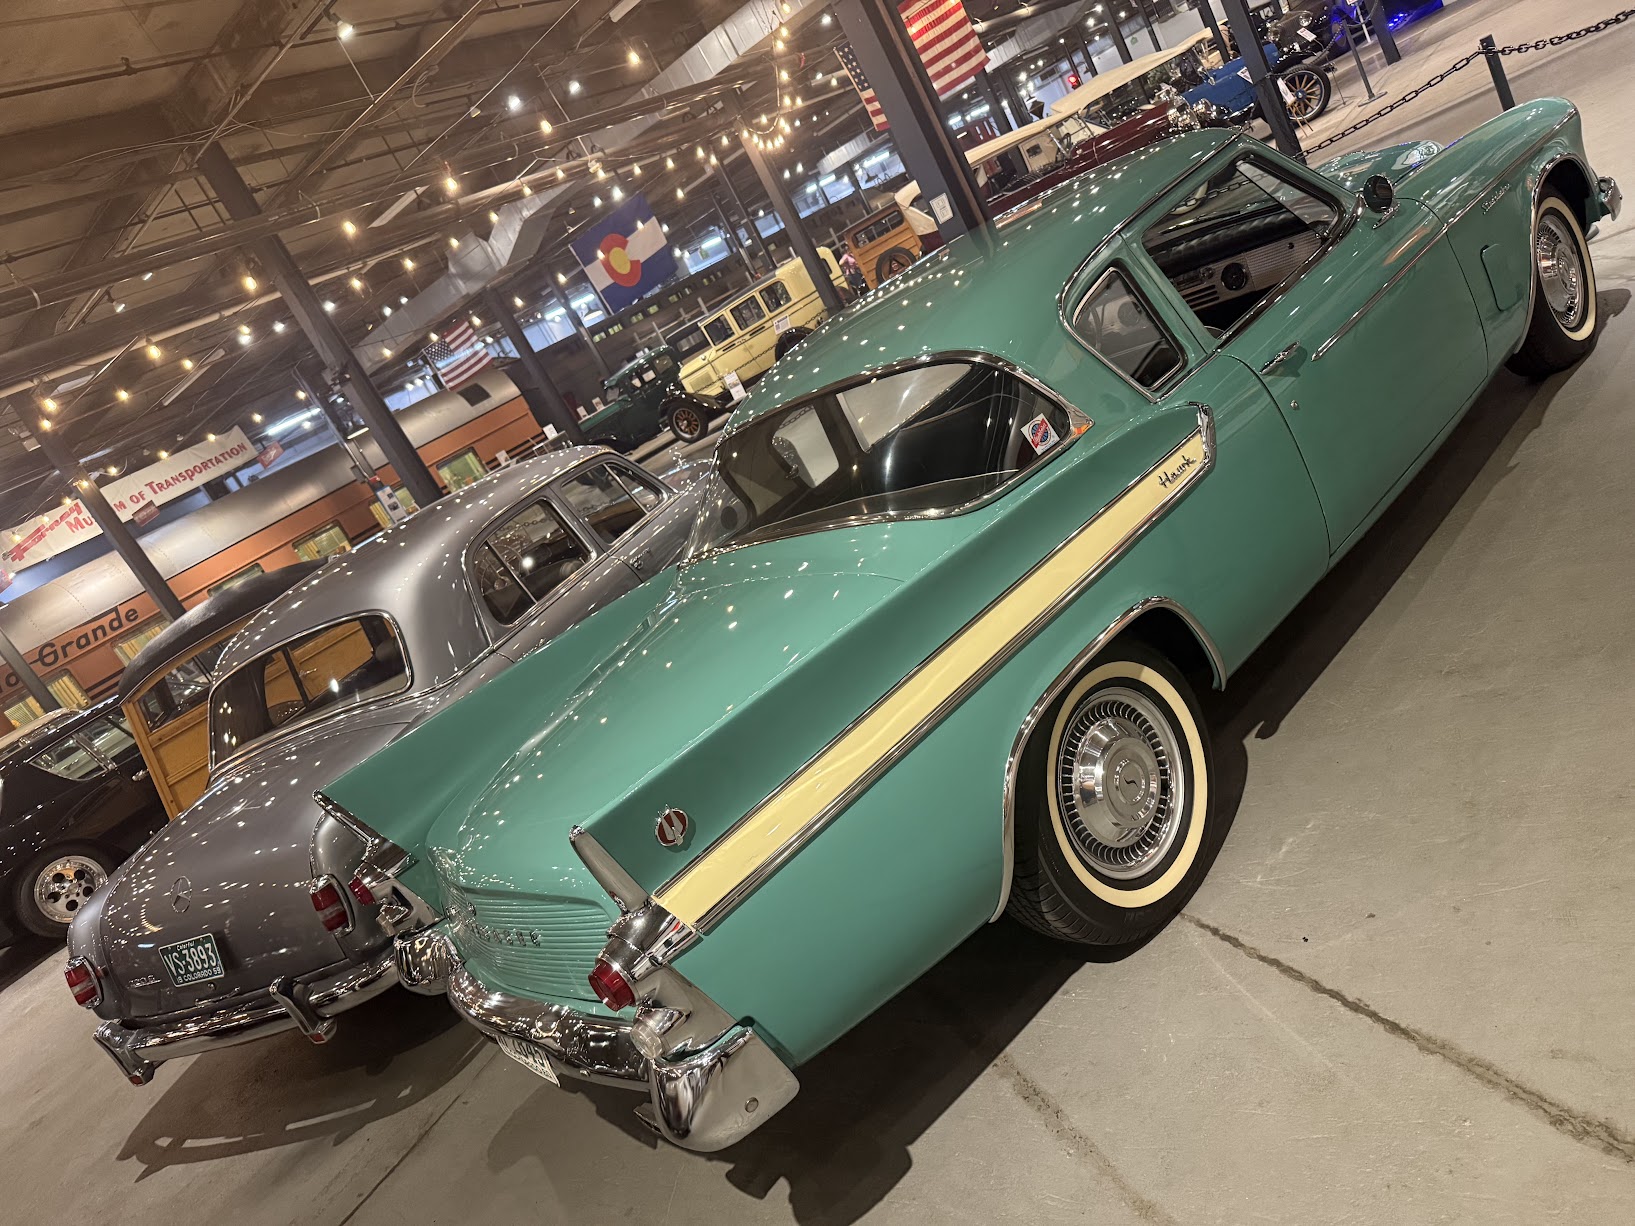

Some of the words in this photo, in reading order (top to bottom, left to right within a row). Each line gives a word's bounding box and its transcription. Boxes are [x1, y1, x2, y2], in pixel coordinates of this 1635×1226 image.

[1158, 454, 1196, 488] Hawk
[30, 605, 139, 667] Grande
[183, 969, 212, 982] COLORADO
